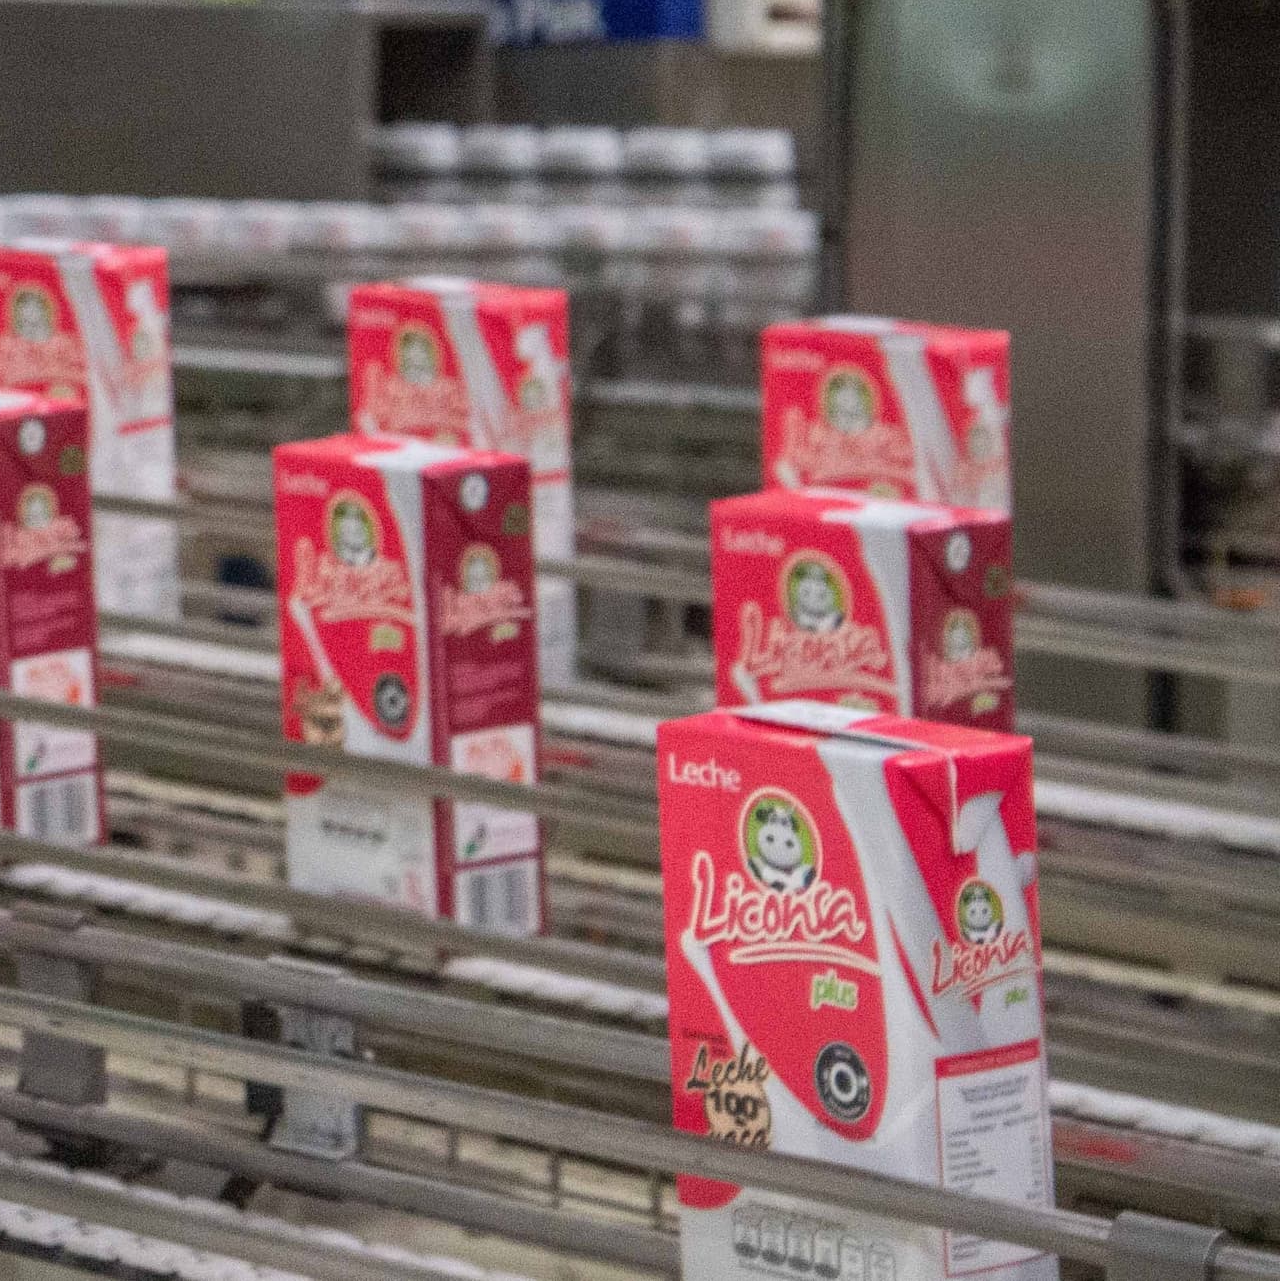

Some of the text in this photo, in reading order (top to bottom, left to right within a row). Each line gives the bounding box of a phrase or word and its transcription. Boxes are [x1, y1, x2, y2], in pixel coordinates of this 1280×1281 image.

[668, 752, 741, 792] Leche
[690, 849, 866, 946] Liconsa
[686, 1040, 769, 1089] Leche
